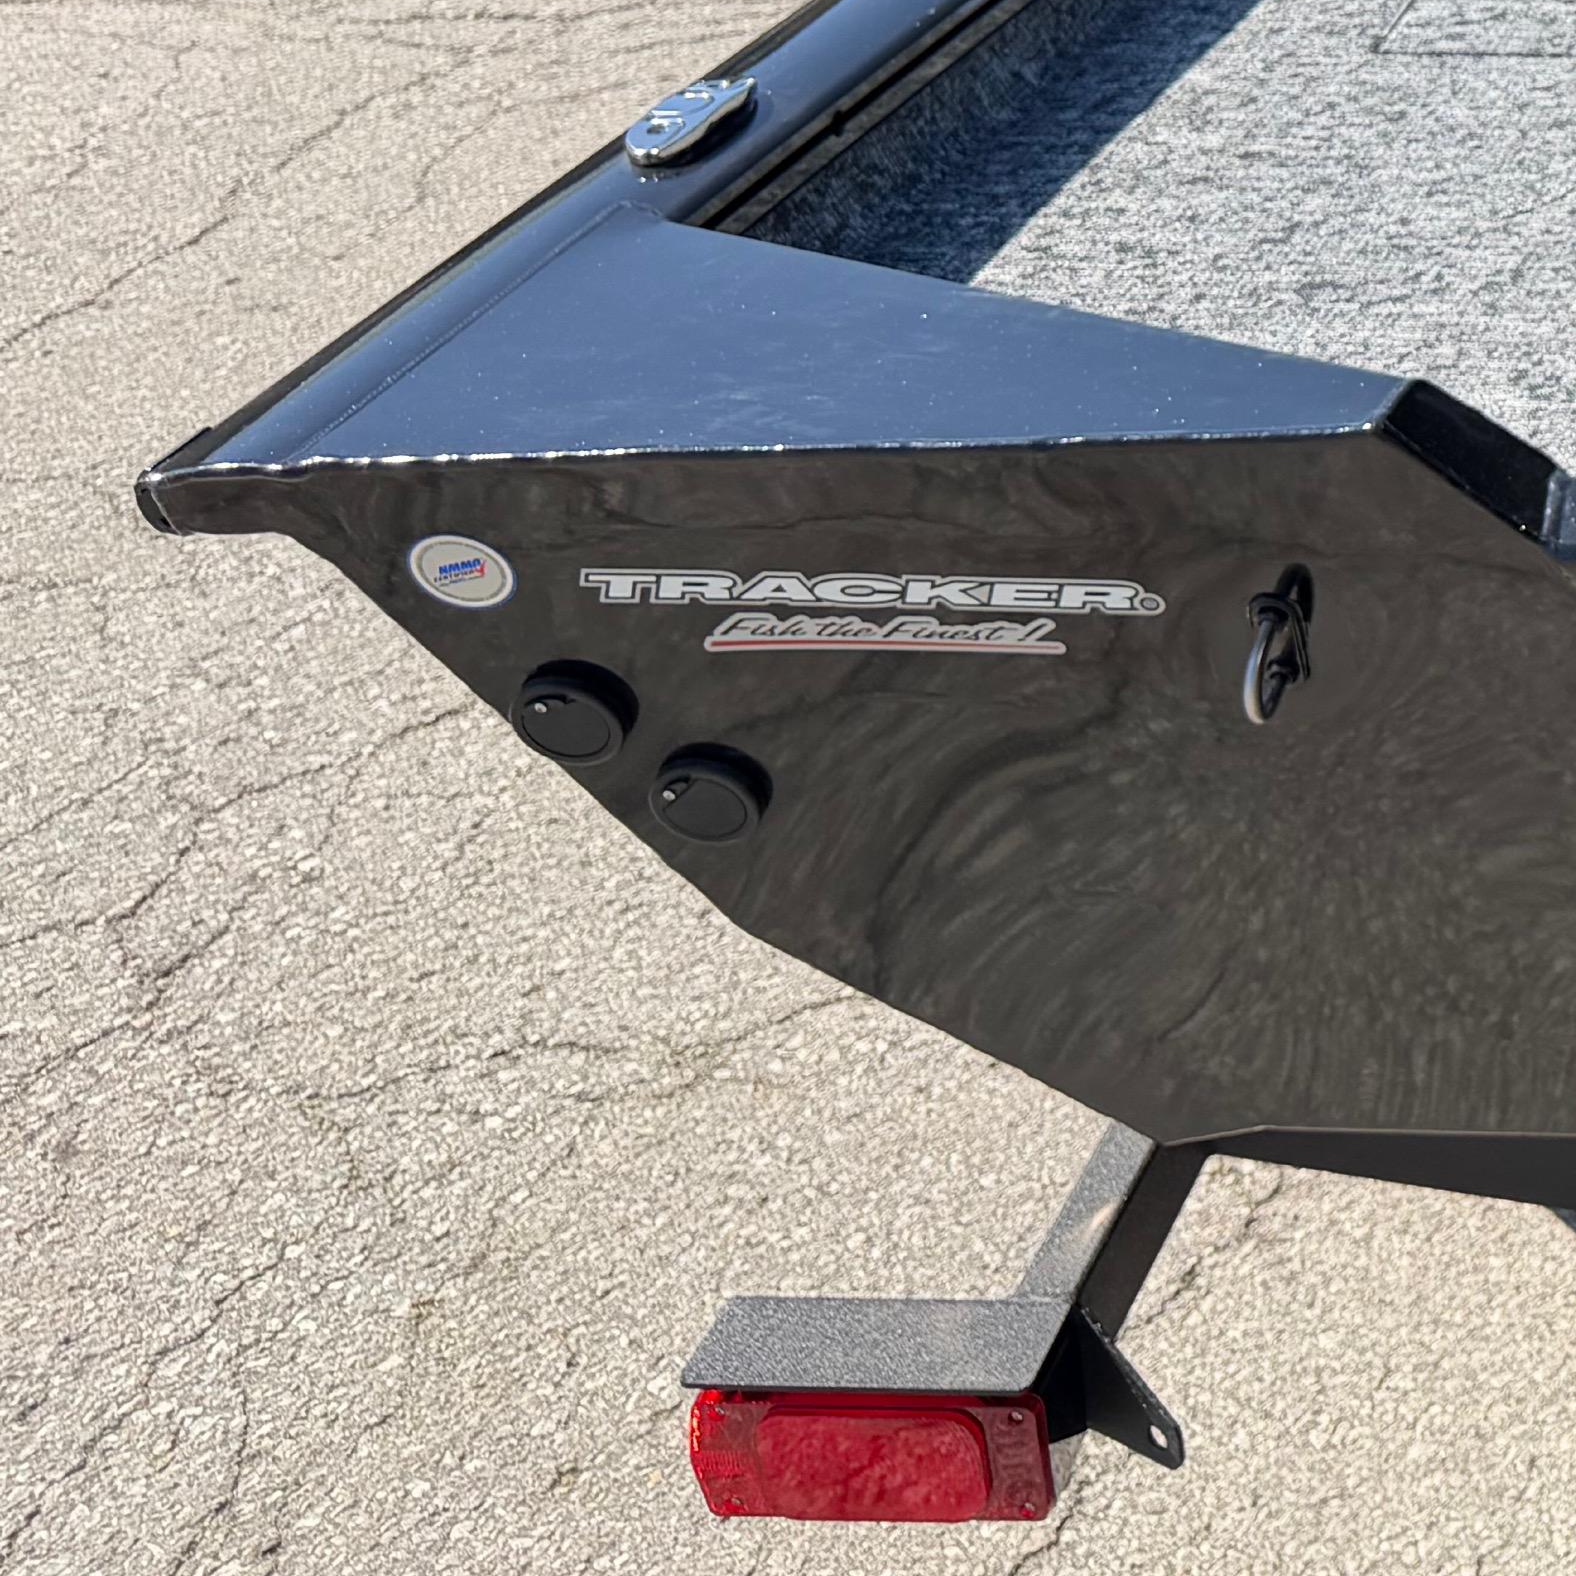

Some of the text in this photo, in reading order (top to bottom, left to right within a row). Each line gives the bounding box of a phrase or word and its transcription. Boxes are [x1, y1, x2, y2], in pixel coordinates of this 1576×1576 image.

[439, 559, 481, 574] NMMA
[583, 572, 1142, 611] TRACKER
[719, 615, 809, 638] Fish
[815, 617, 877, 638] the
